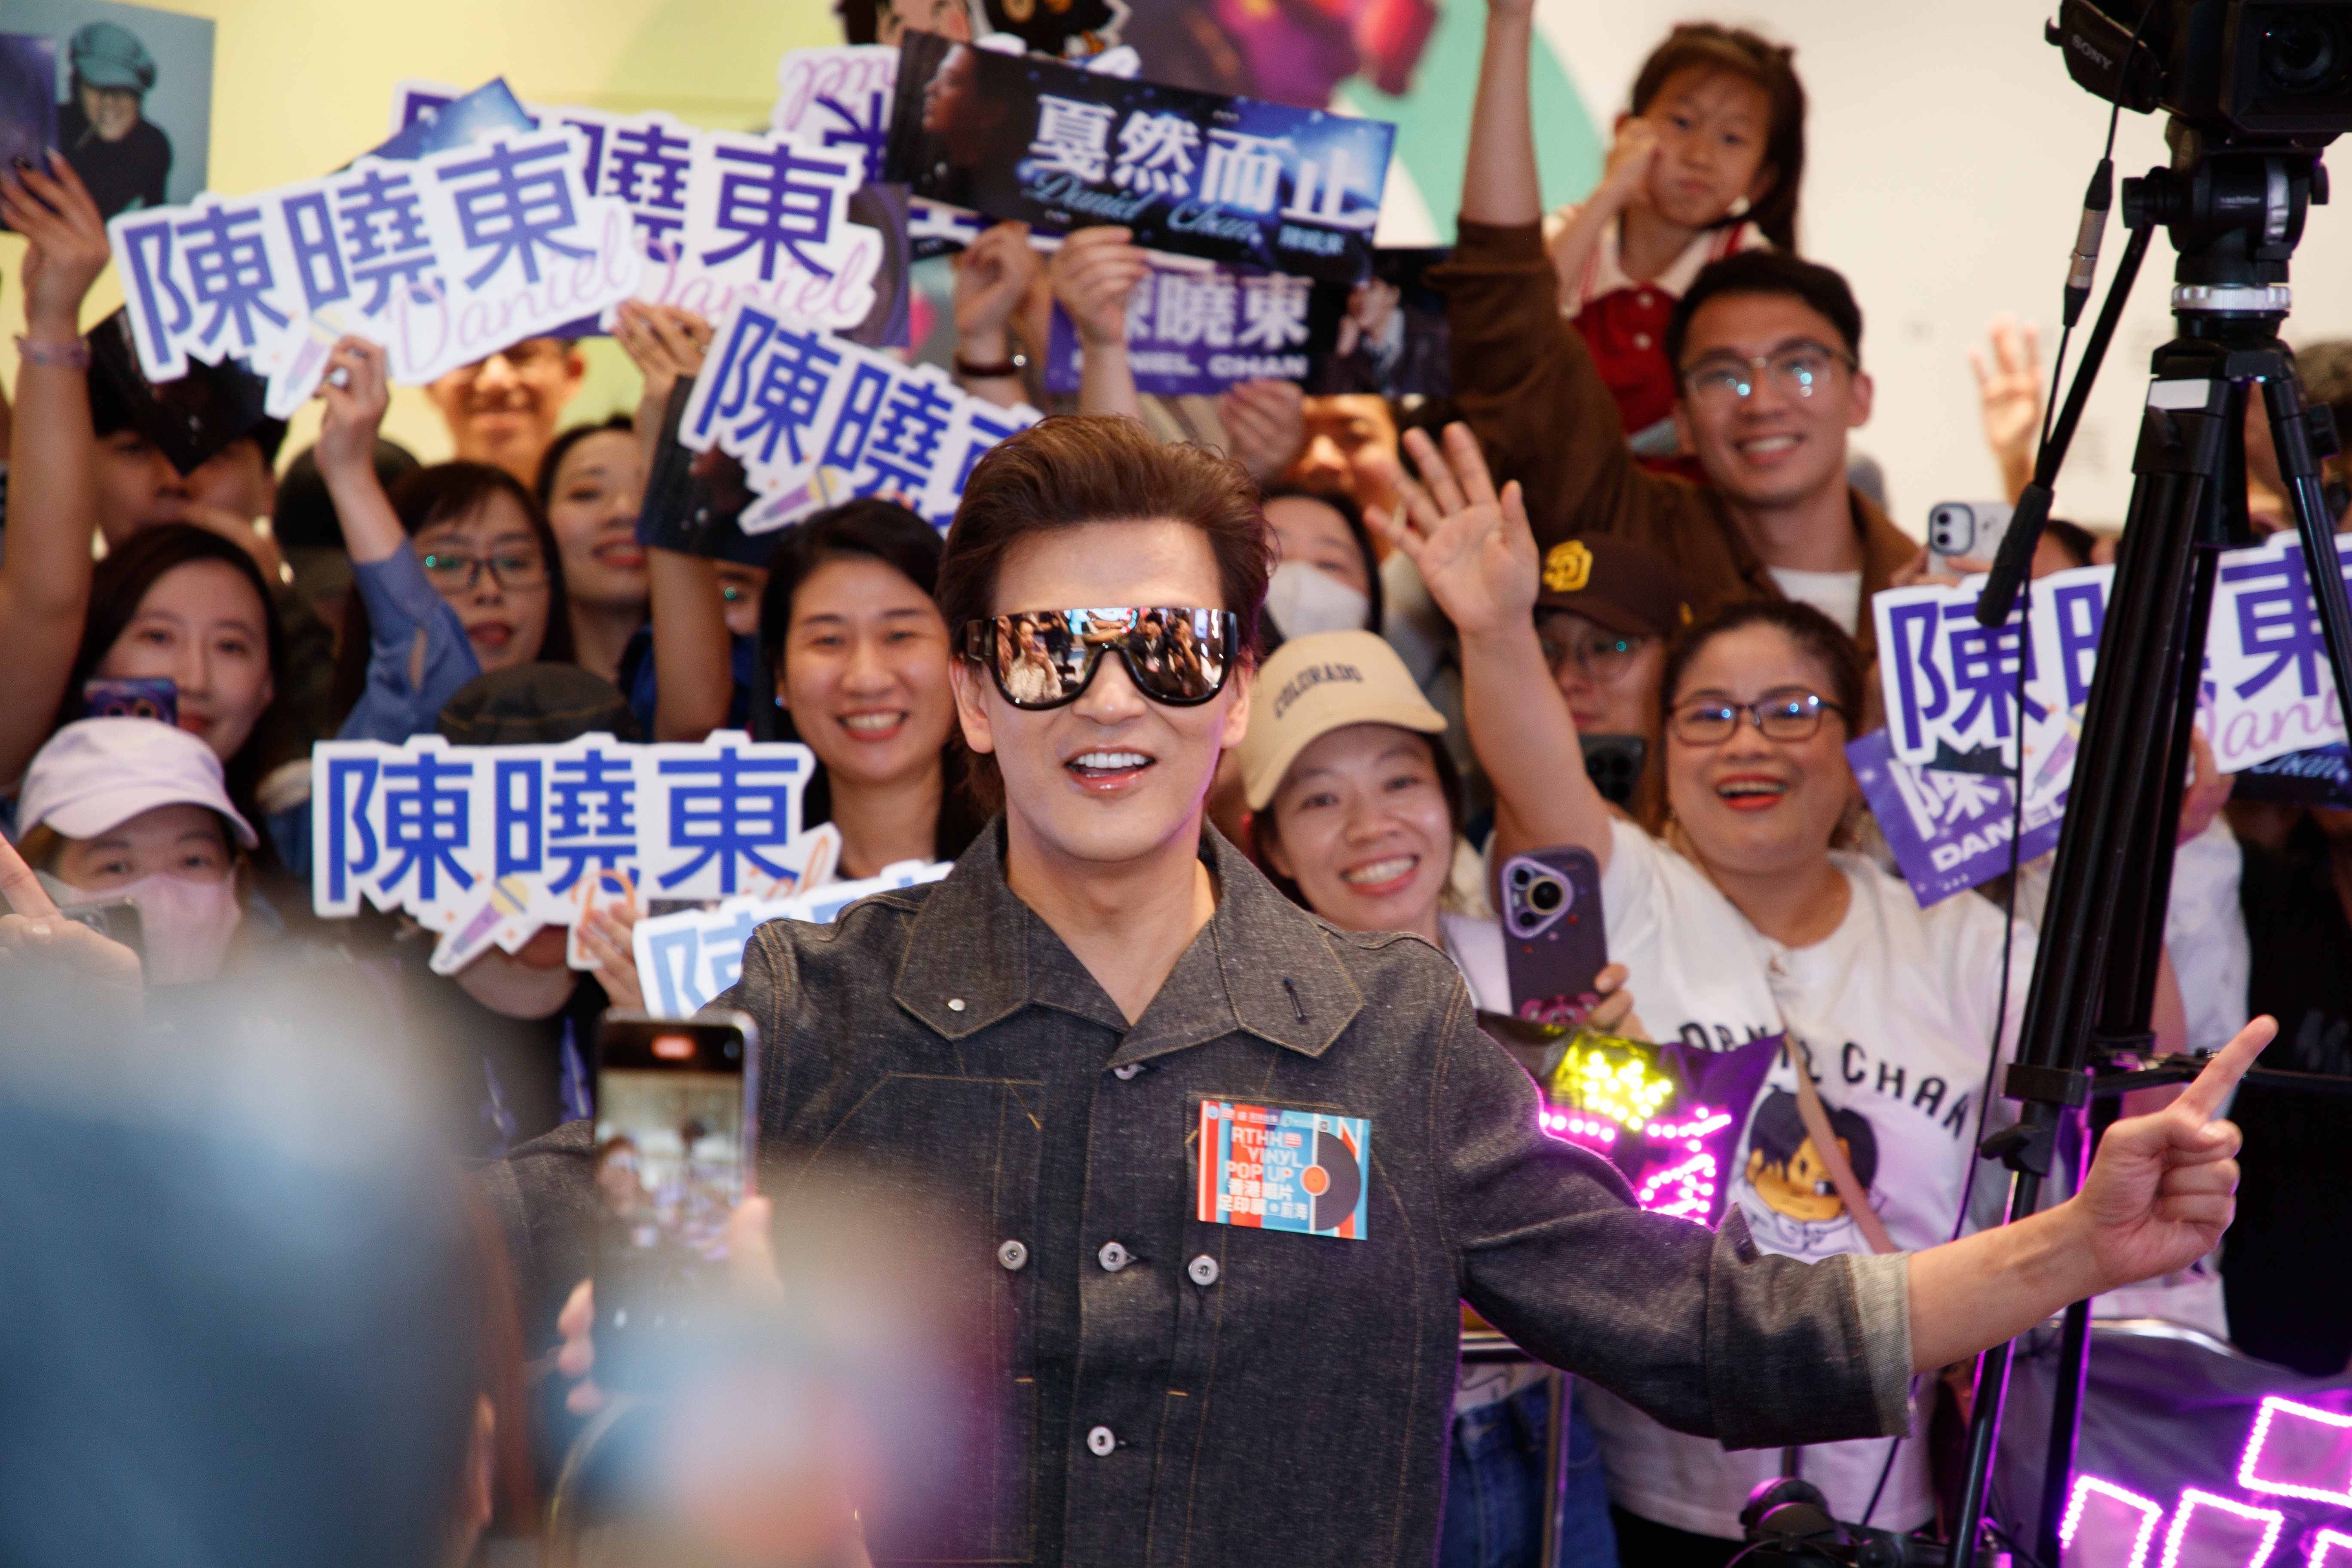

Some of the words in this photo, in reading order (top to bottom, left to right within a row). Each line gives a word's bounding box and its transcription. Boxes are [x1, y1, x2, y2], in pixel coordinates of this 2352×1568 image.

[2072, 34, 2113, 70] SONY
[122, 140, 597, 365] 陳曉東
[384, 207, 632, 377] Daniel
[328, 747, 799, 903] 陳曉東
[1225, 1160, 1263, 1180] POP
[1267, 1165, 1294, 1182] UP
[1242, 1146, 1304, 1168] VINYL
